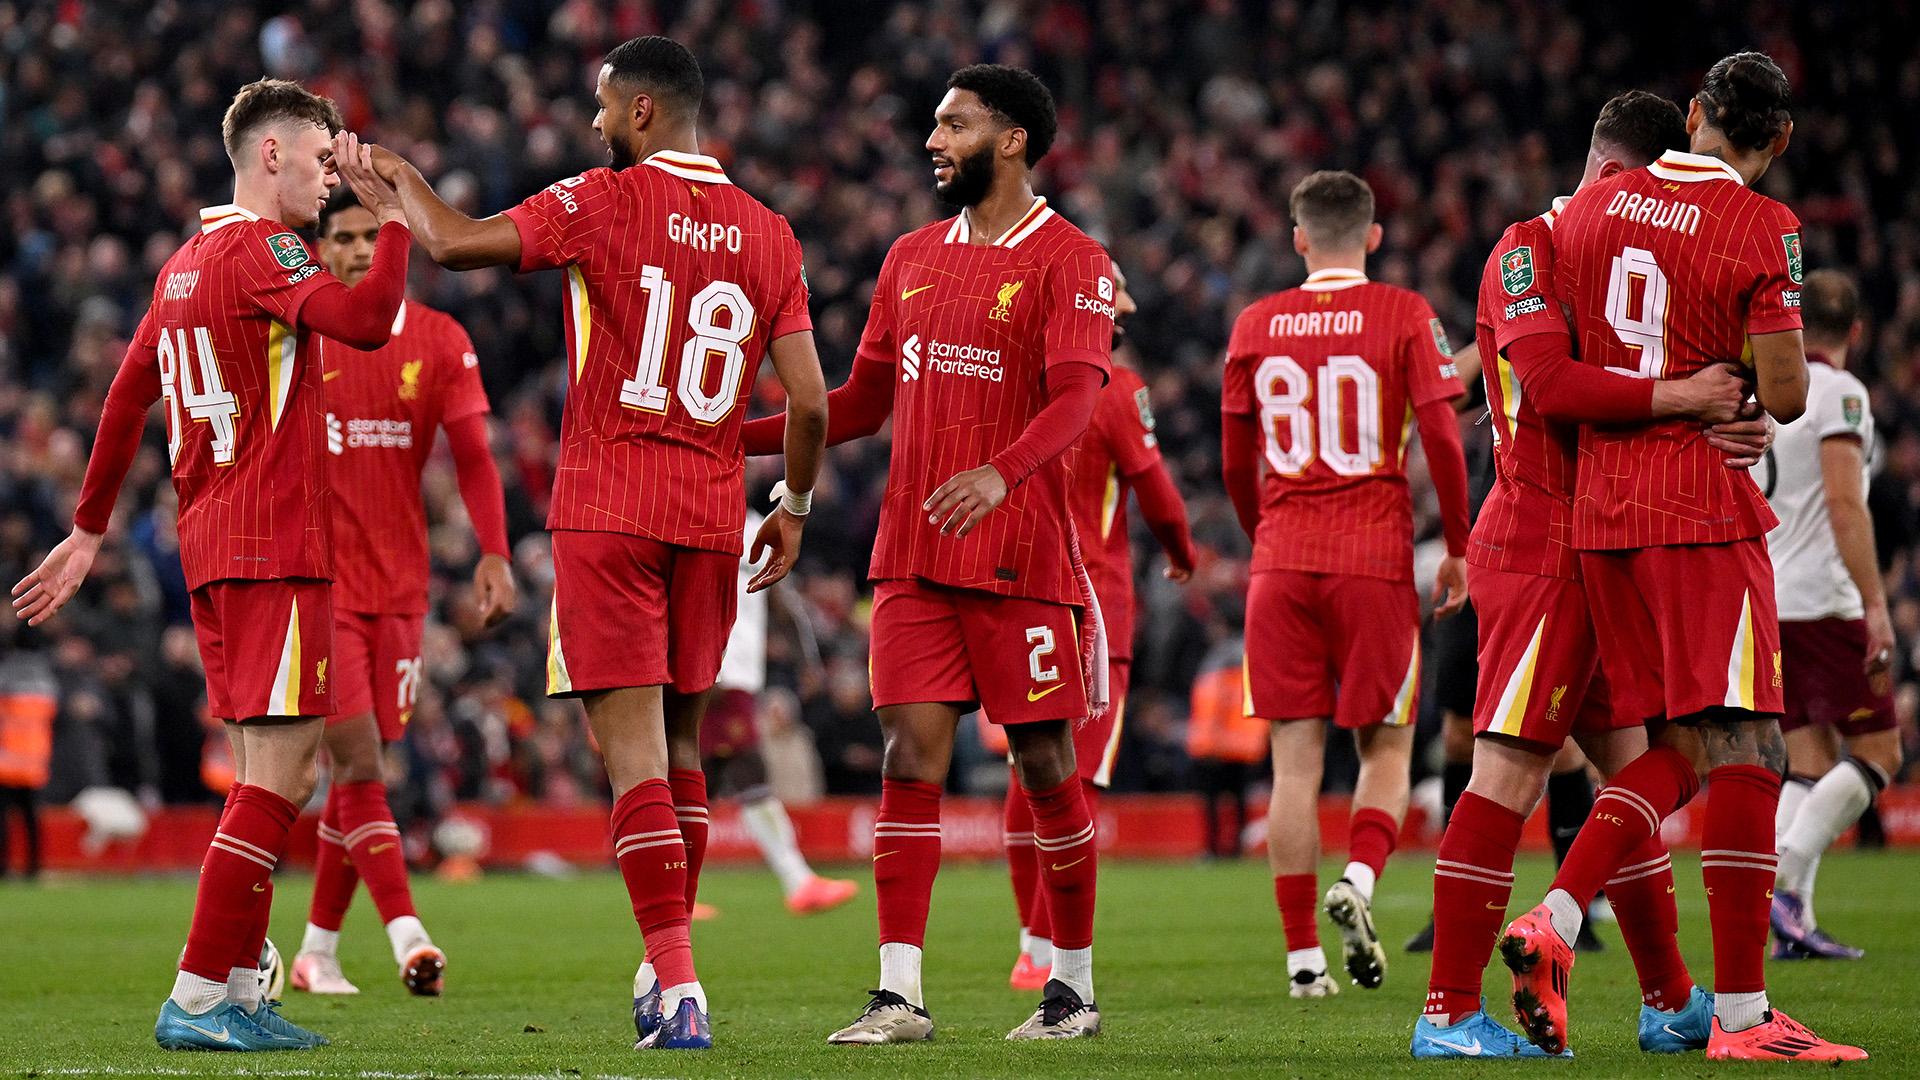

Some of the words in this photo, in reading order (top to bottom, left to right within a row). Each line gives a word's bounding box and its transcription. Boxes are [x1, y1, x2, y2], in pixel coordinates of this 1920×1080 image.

[549, 184, 578, 214] edia
[1606, 190, 1700, 236] DARWIN
[668, 213, 742, 254] GAKPO
[1505, 304, 1516, 314] No
[1516, 297, 1541, 308] room
[1506, 310, 1517, 321] for
[1517, 303, 1547, 315] racism
[1604, 246, 1670, 380] 9
[1269, 310, 1363, 337] MORTON
[619, 265, 757, 427] 18
[927, 355, 1004, 382] hartered
[157, 327, 241, 469] 84
[1254, 355, 1384, 478] 80
[1026, 625, 1060, 683] 2
[1595, 812, 1624, 827] LFC
[665, 861, 687, 870] LFC
